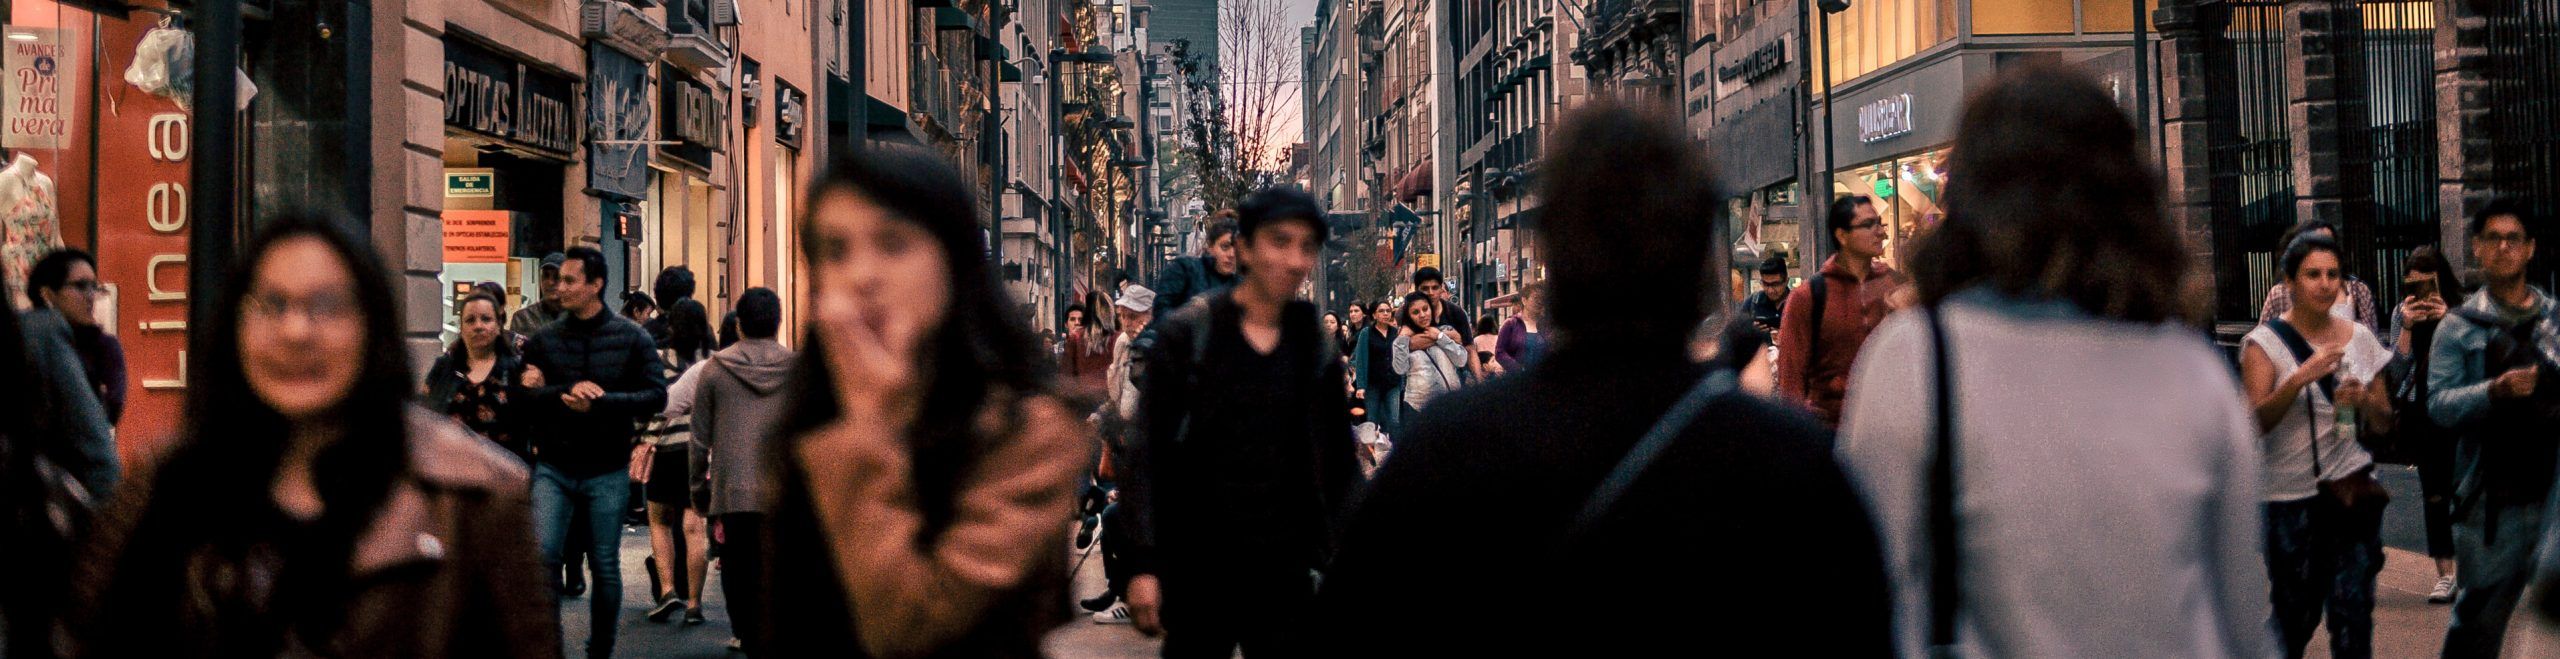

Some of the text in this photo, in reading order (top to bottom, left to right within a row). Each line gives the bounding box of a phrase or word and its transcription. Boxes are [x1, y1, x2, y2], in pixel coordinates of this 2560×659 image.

[17, 43, 65, 57] AVANCES
[17, 67, 56, 93] Pri
[20, 96, 56, 114] ma
[444, 61, 510, 135] OPTICAS
[12, 117, 65, 136] vera
[139, 113, 188, 388] Linea
